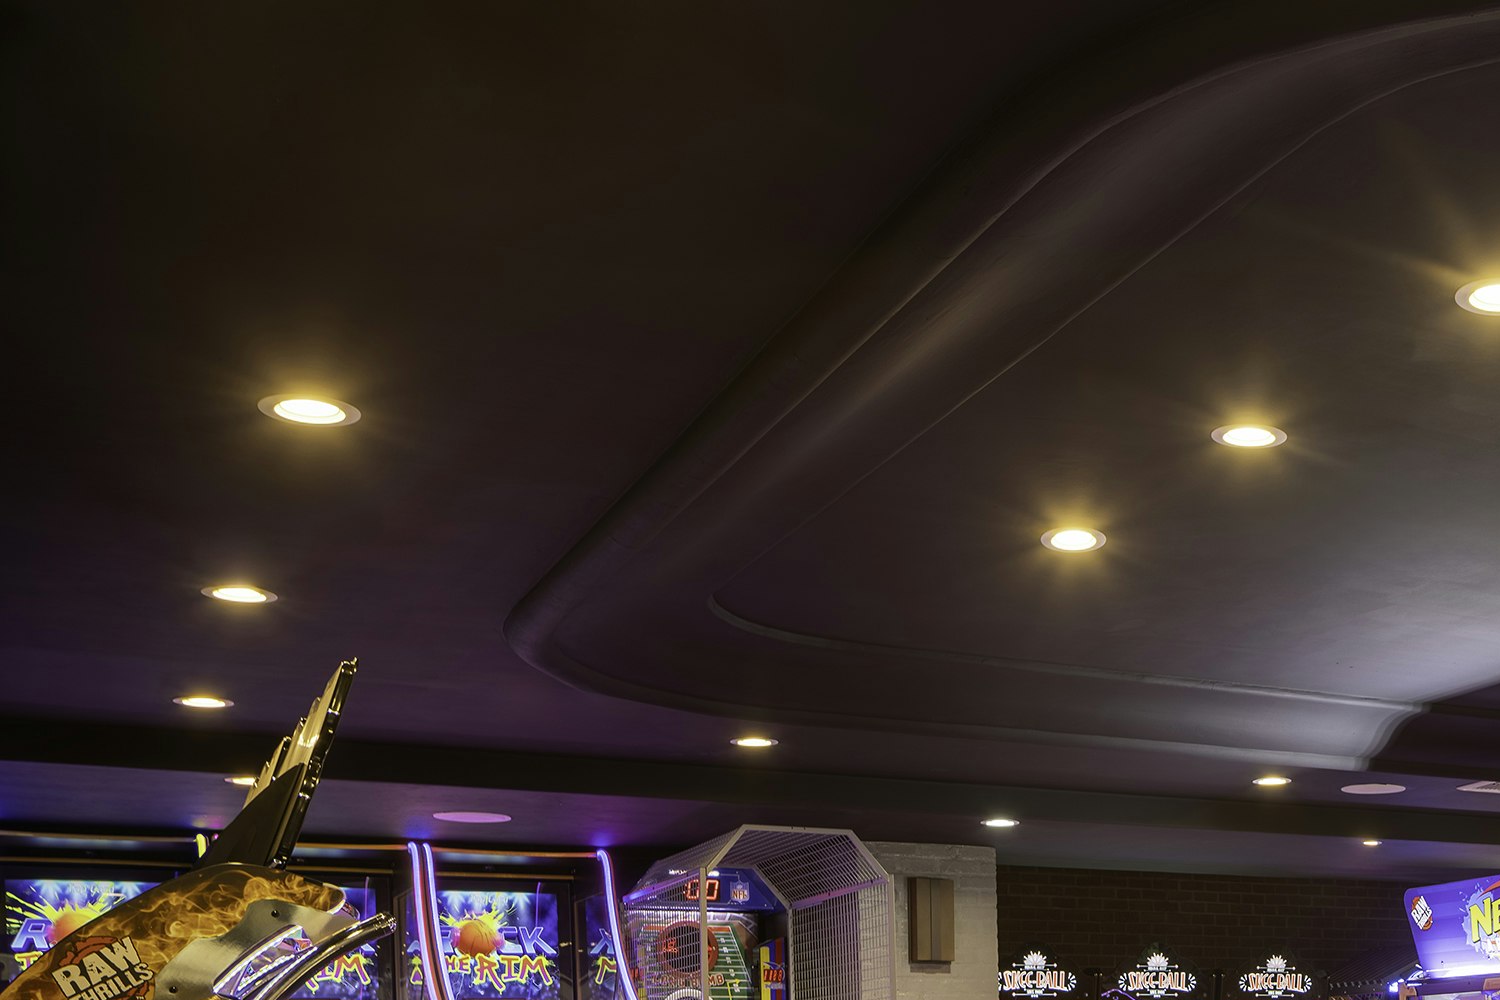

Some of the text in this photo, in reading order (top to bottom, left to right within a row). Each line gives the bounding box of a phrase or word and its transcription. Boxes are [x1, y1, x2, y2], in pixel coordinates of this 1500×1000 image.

[1411, 896, 1429, 922] RAW
[52, 936, 141, 998] RAW
[475, 953, 553, 995] RIM
[692, 974, 724, 986] BMB
[1003, 970, 1068, 992] SKEE-BALL
[1128, 971, 1190, 992] SKEE-BALL
[1248, 973, 1305, 993] SKEE-BALL
